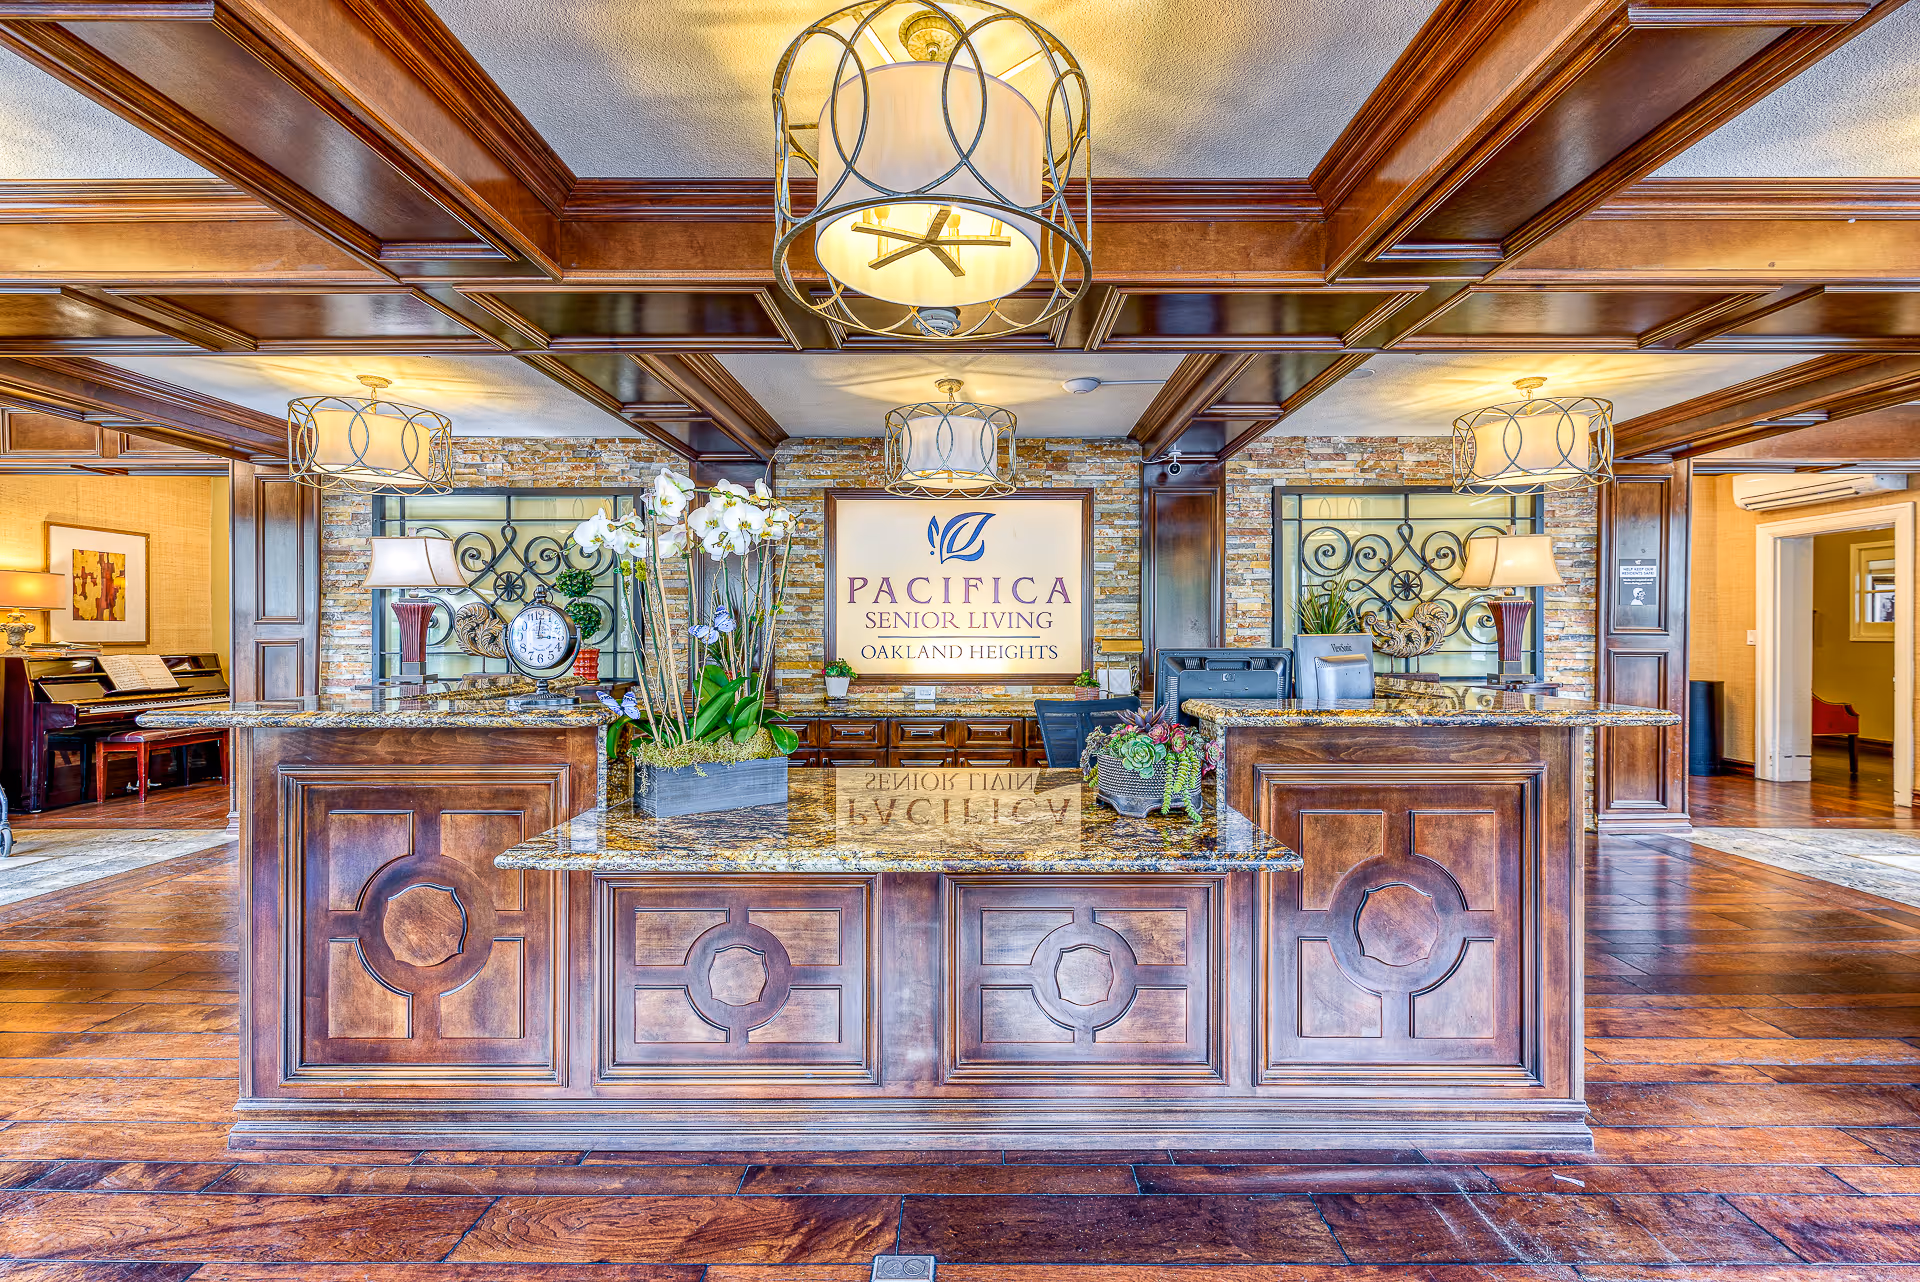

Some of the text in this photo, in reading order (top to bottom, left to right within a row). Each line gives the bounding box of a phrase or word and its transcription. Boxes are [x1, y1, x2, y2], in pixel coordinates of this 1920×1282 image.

[847, 577, 1072, 604] PACIFICA
[535, 610, 545, 620] 12
[865, 611, 1053, 630] SENIOR LIVING
[519, 643, 527, 654] 8
[861, 644, 1058, 660] OAKLAND HEIGHTS
[528, 651, 534, 660] 7
[537, 653, 544, 664] 6
[548, 650, 554, 660] 5
